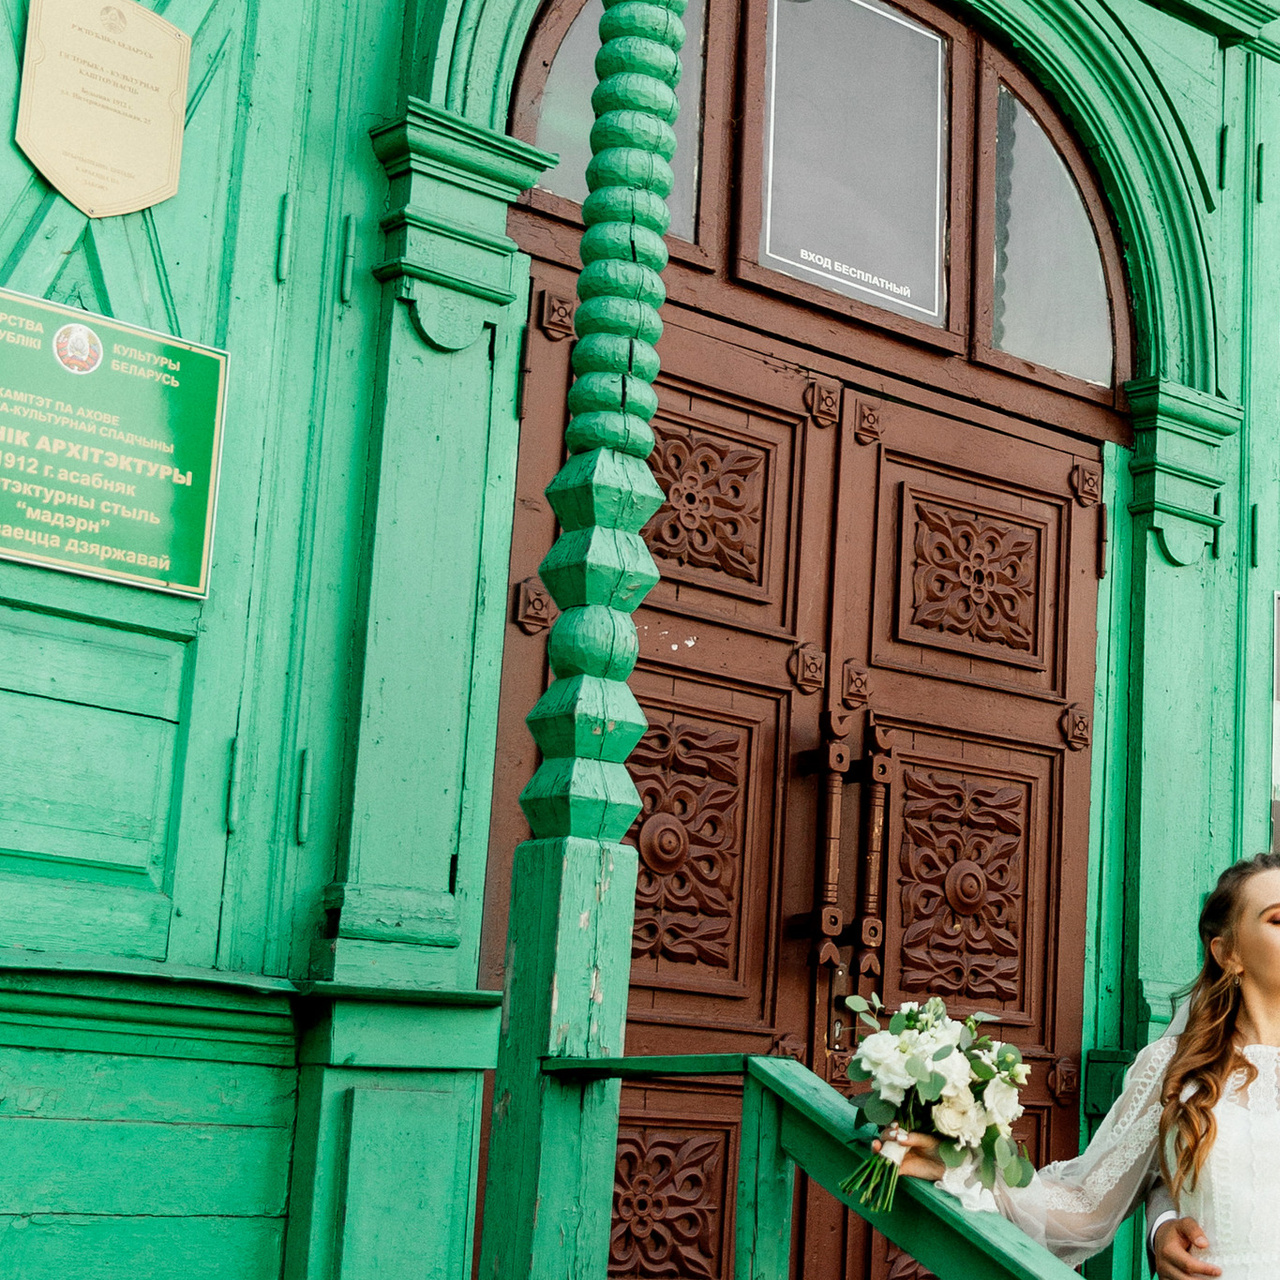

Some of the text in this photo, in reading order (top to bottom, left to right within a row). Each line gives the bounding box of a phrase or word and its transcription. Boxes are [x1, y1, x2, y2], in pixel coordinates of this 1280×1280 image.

[800, 248, 911, 298] ВХОД БЕСПЛАТНЫЙ
[111, 359, 180, 387] БЕЛАРУСЬ
[113, 343, 181, 371] КУЛЬТУРЫ
[55, 400, 73, 415] ПА
[76, 406, 121, 427] АХОВЕ
[99, 426, 174, 453] СПАДЧЫНЫ
[34, 434, 193, 486] АРХІТЭКТУРЫ
[43, 464, 55, 478] г.
[57, 468, 136, 497] асабняк
[0, 477, 161, 525] тэктурны стыль
[0, 524, 171, 571] аецца дзяржавай
